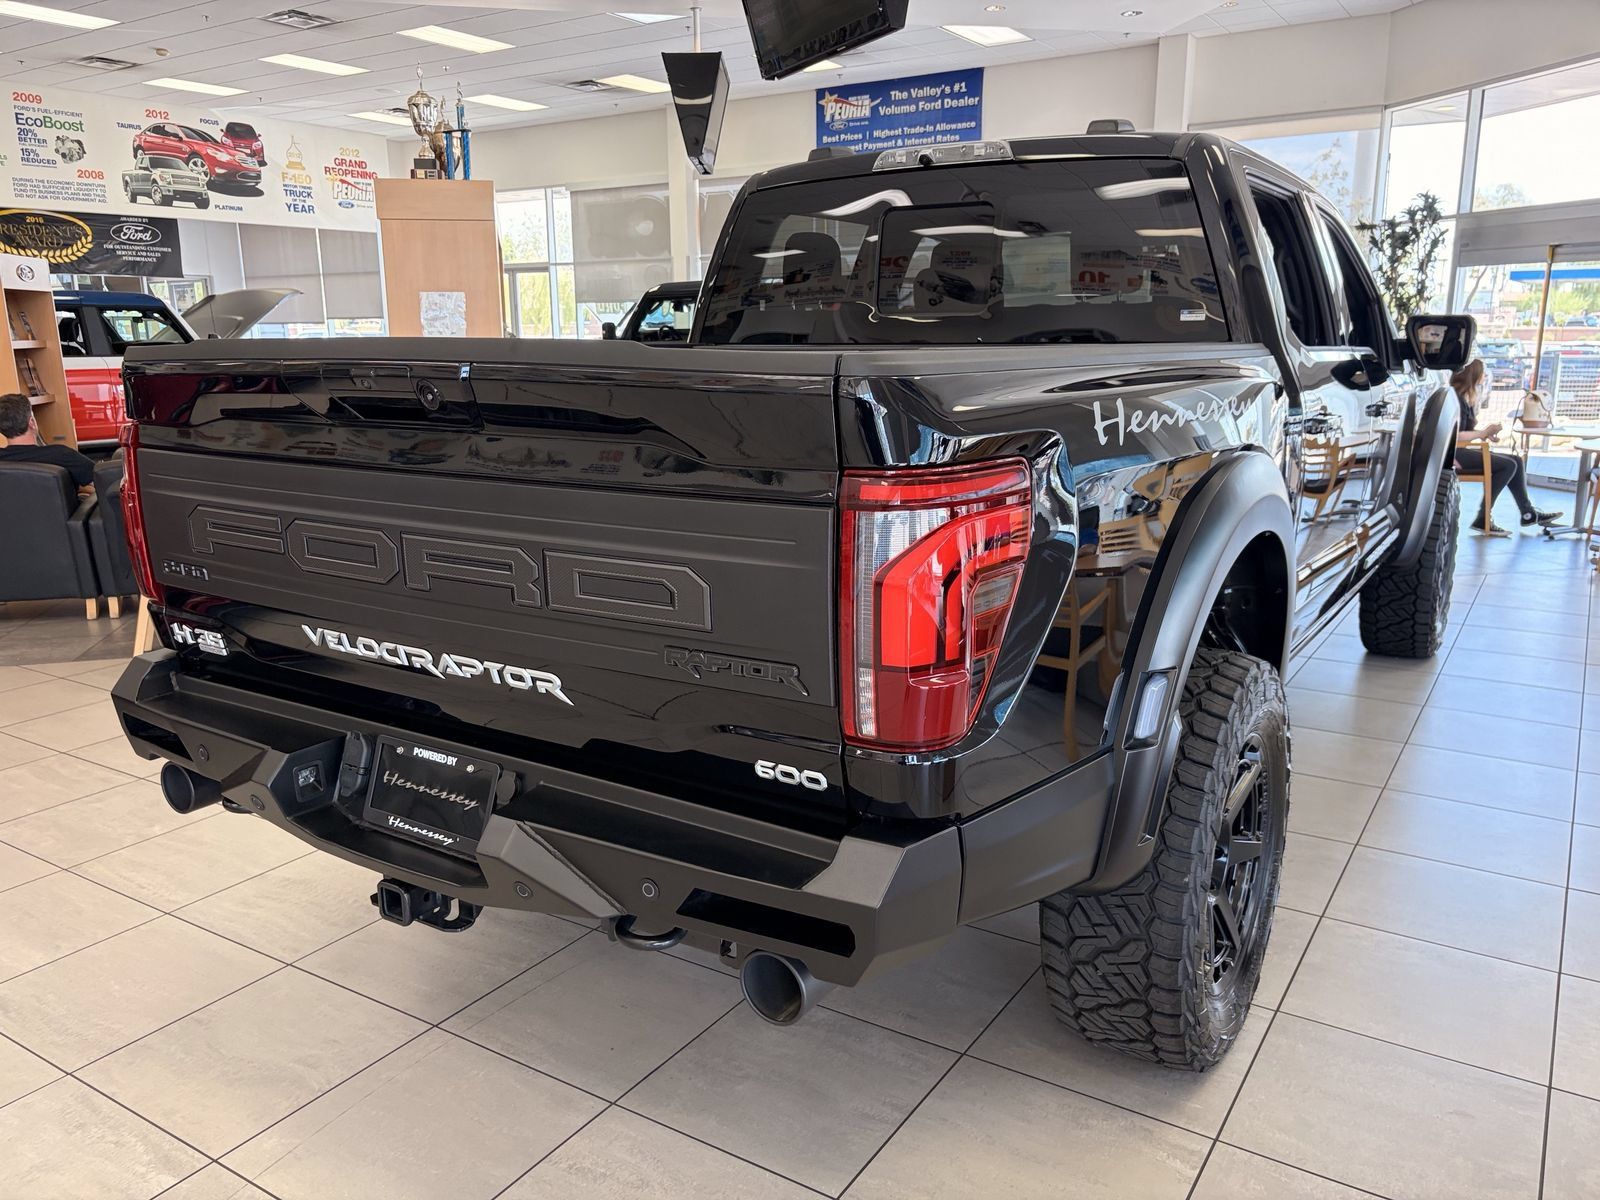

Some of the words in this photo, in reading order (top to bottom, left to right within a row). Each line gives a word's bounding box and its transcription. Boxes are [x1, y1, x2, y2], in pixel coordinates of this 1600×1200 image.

[12, 92, 42, 104] 2009
[890, 90, 908, 100] The
[910, 84, 951, 98] Valley's
[953, 82, 967, 93] #1
[37, 108, 83, 118] FUEL-EFFICIENT
[879, 104, 916, 116] Volume
[919, 100, 941, 111] Ford
[944, 96, 980, 109] Dealer
[145, 109, 169, 120] 2012
[14, 112, 85, 132] EcoBoost
[116, 122, 142, 130] TAURUS
[200, 118, 219, 126] FOCUS
[17, 127, 38, 137] 20%
[823, 135, 839, 143] Best
[840, 133, 863, 141] Prices
[873, 128, 901, 138] Highest
[903, 125, 933, 134] Trade-In
[935, 121, 976, 131] Allowance
[18, 136, 48, 144] BETTER
[863, 141, 896, 150] Payment
[904, 137, 935, 146] Interest
[937, 134, 960, 142] Rates
[20, 147, 40, 158] 15%
[339, 147, 360, 158] 2012
[20, 156, 57, 165] REDUCED
[333, 157, 367, 170] GRAND
[77, 169, 105, 180] 2008
[281, 171, 312, 185] F-150
[324, 166, 378, 180] REOPENING
[46, 179, 75, 187] ECONOMIC
[283, 188, 314, 200] TRUCK
[214, 204, 243, 212] PLATINUM
[285, 202, 316, 215] YEAR
[0, 223, 83, 238] RESIDENT'S
[120, 225, 153, 241] Ford
[1092, 396, 1253, 447] Hennessey
[187, 503, 714, 633] FORD
[301, 624, 575, 706] VELOCIRAPTOR
[663, 646, 811, 697] RAPTOR
[413, 747, 447, 764] POWERED
[447, 757, 458, 766] BY
[754, 759, 829, 792] 600
[383, 770, 479, 811] Hennessey
[389, 816, 454, 845] Hennessey
